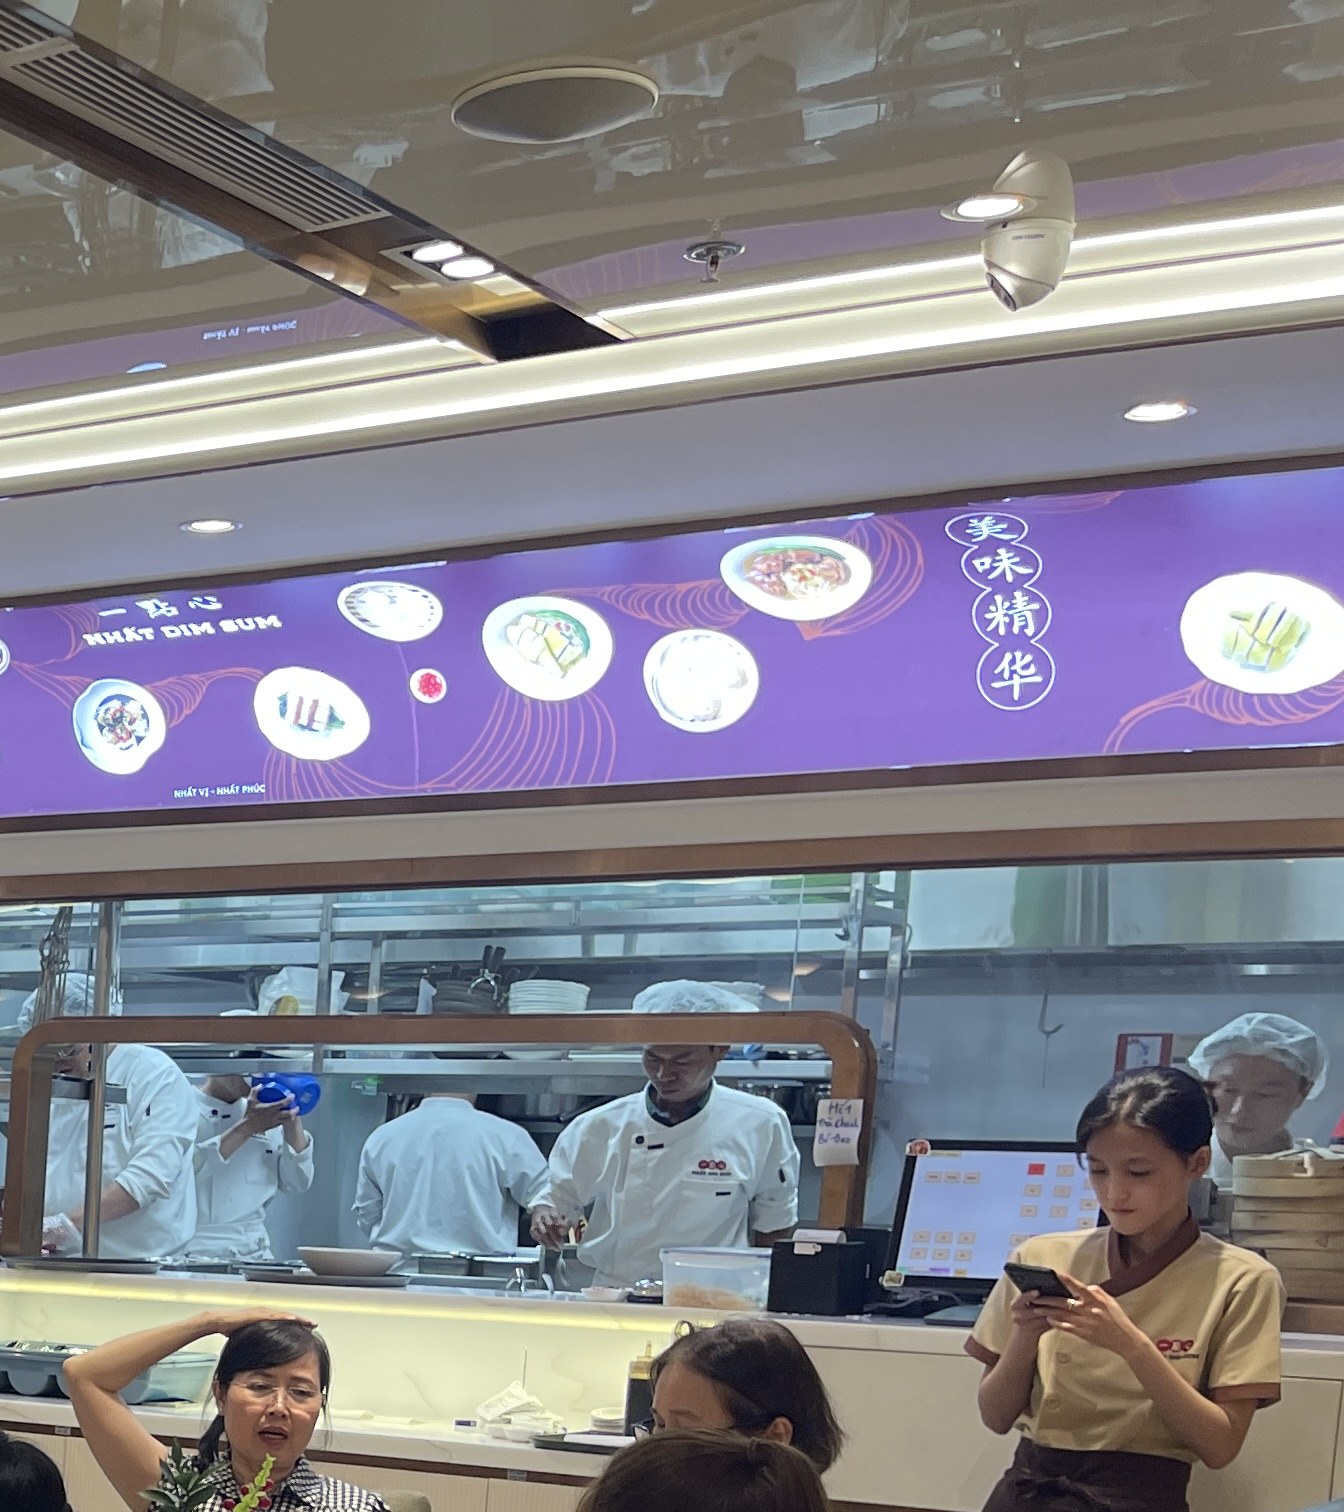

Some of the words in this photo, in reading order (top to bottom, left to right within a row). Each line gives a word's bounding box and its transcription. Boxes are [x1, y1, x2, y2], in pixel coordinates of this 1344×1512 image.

[965, 515, 1043, 701] 美味精华
[160, 621, 215, 639] DIM
[219, 614, 282, 633] SUM
[173, 786, 197, 798] NHẤT
[216, 784, 240, 795] NHẤT
[241, 782, 266, 794] PHÚC
